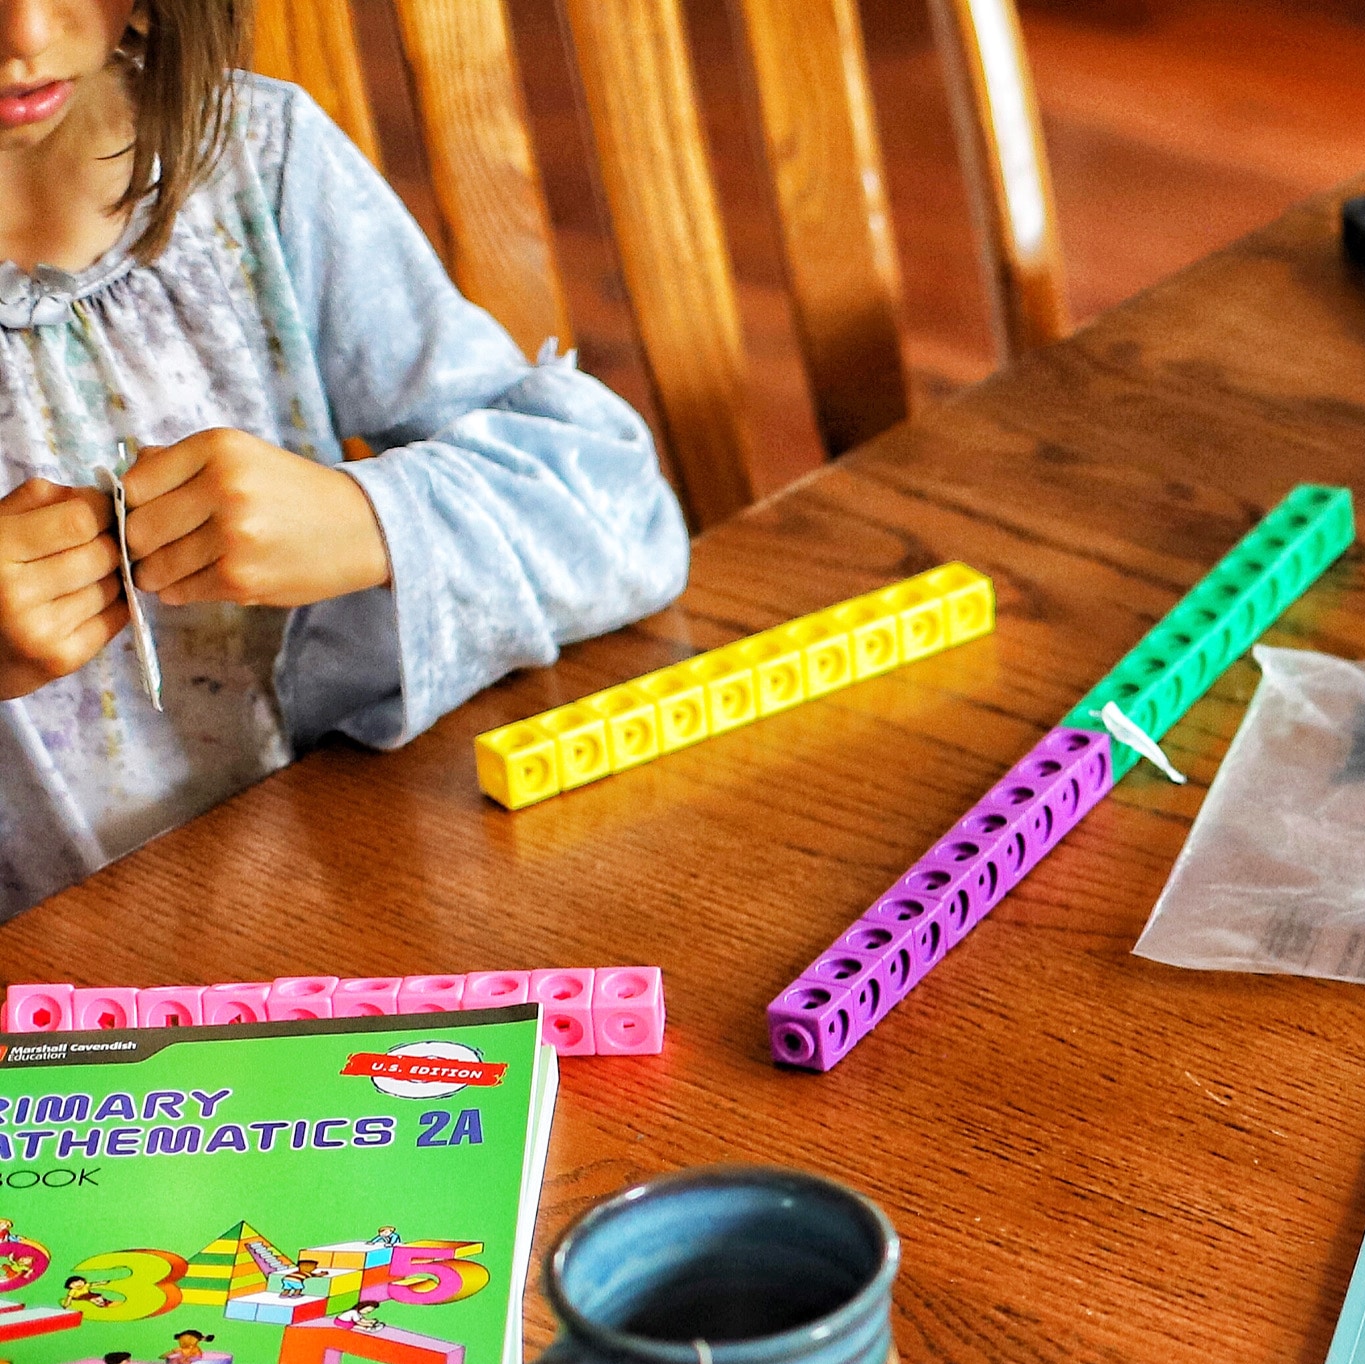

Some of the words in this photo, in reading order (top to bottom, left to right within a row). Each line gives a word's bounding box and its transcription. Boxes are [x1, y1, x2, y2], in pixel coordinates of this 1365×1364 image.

[8, 1051, 67, 1062] Education
[11, 1043, 67, 1055] Marshall
[70, 1041, 137, 1052] Cavendish
[371, 1062, 402, 1073] U.S.
[409, 1065, 483, 1079] EDITION
[0, 1087, 233, 1125] IMARY
[416, 1109, 483, 1147] 2A
